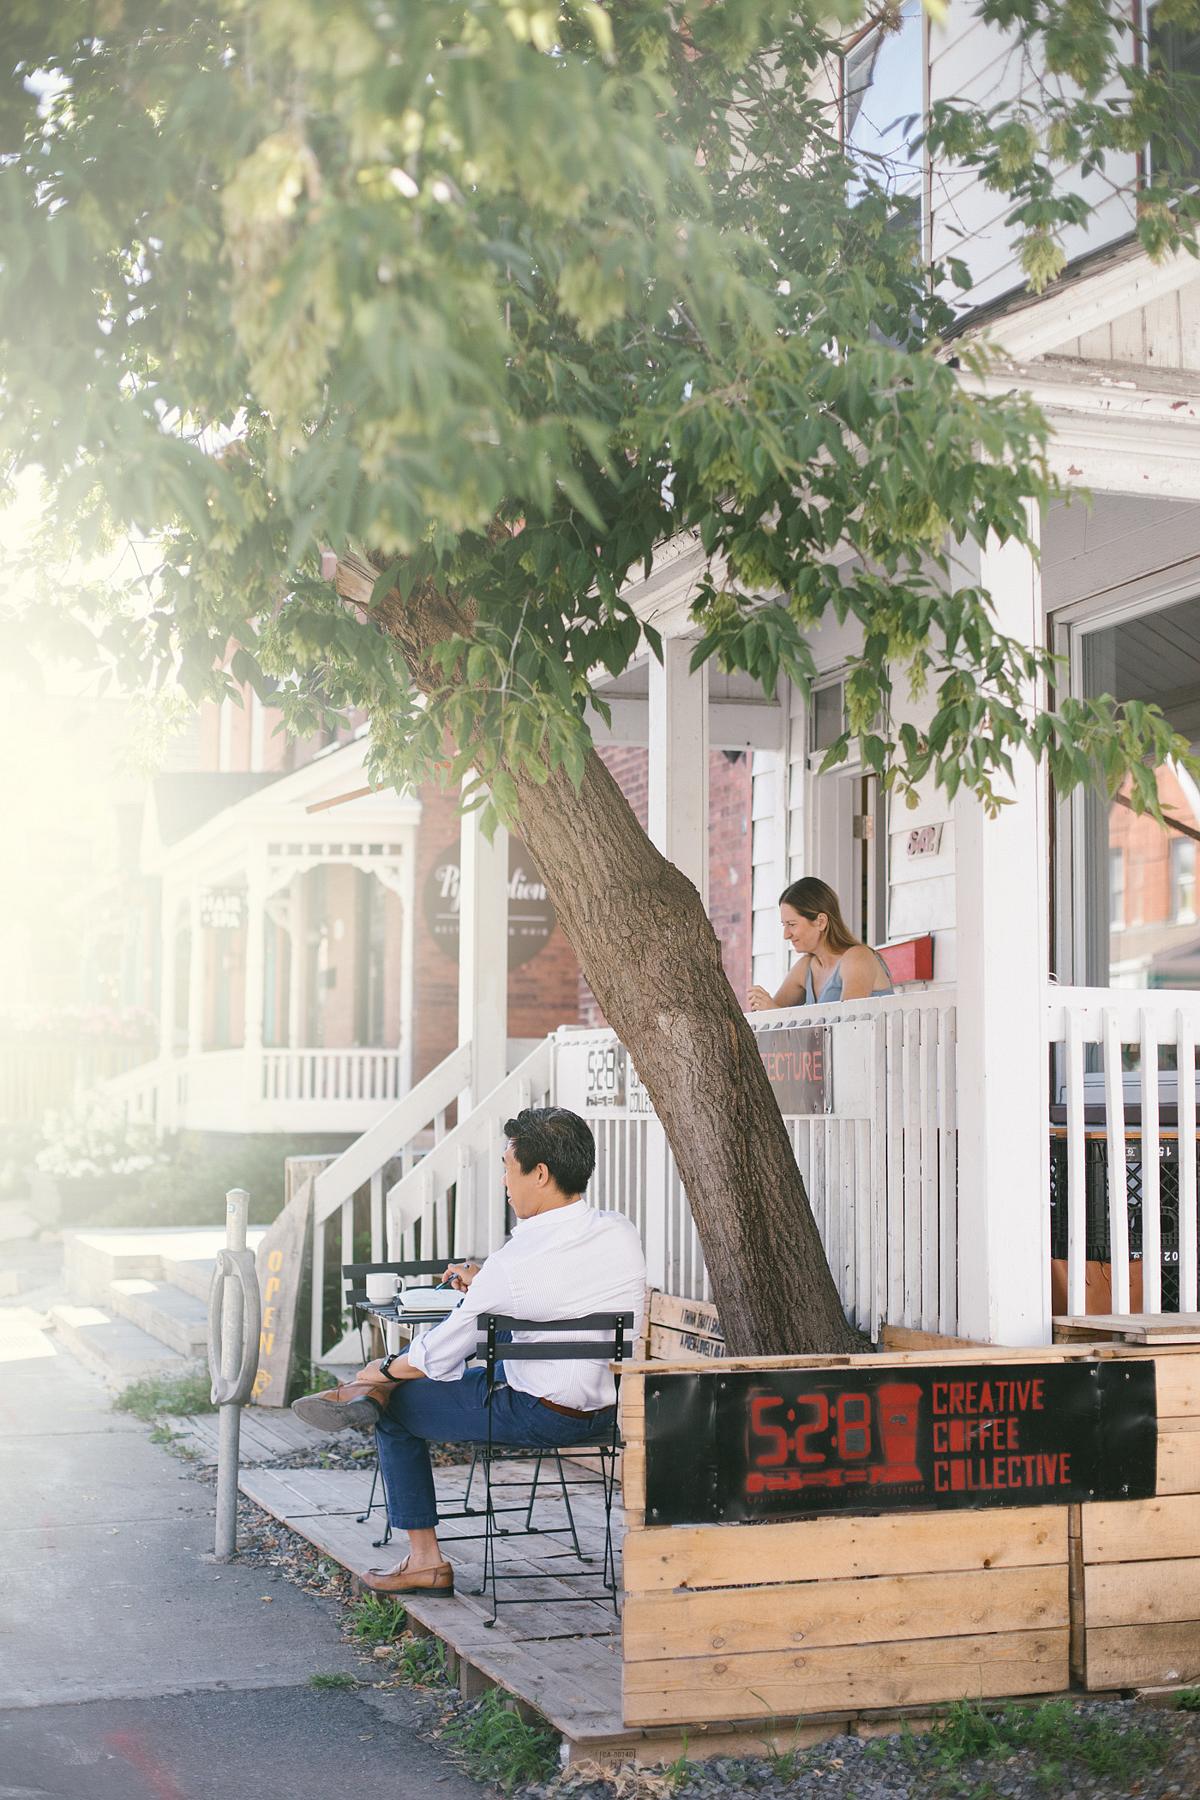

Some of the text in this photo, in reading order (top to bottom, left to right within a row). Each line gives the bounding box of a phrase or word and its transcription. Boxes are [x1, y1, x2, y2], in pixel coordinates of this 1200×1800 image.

[259, 1251, 282, 1356] OPEN
[932, 1378, 1045, 1415] CREATIVE
[933, 1417, 1019, 1453] COFFEE
[934, 1453, 1071, 1492] COLLECTIVE
